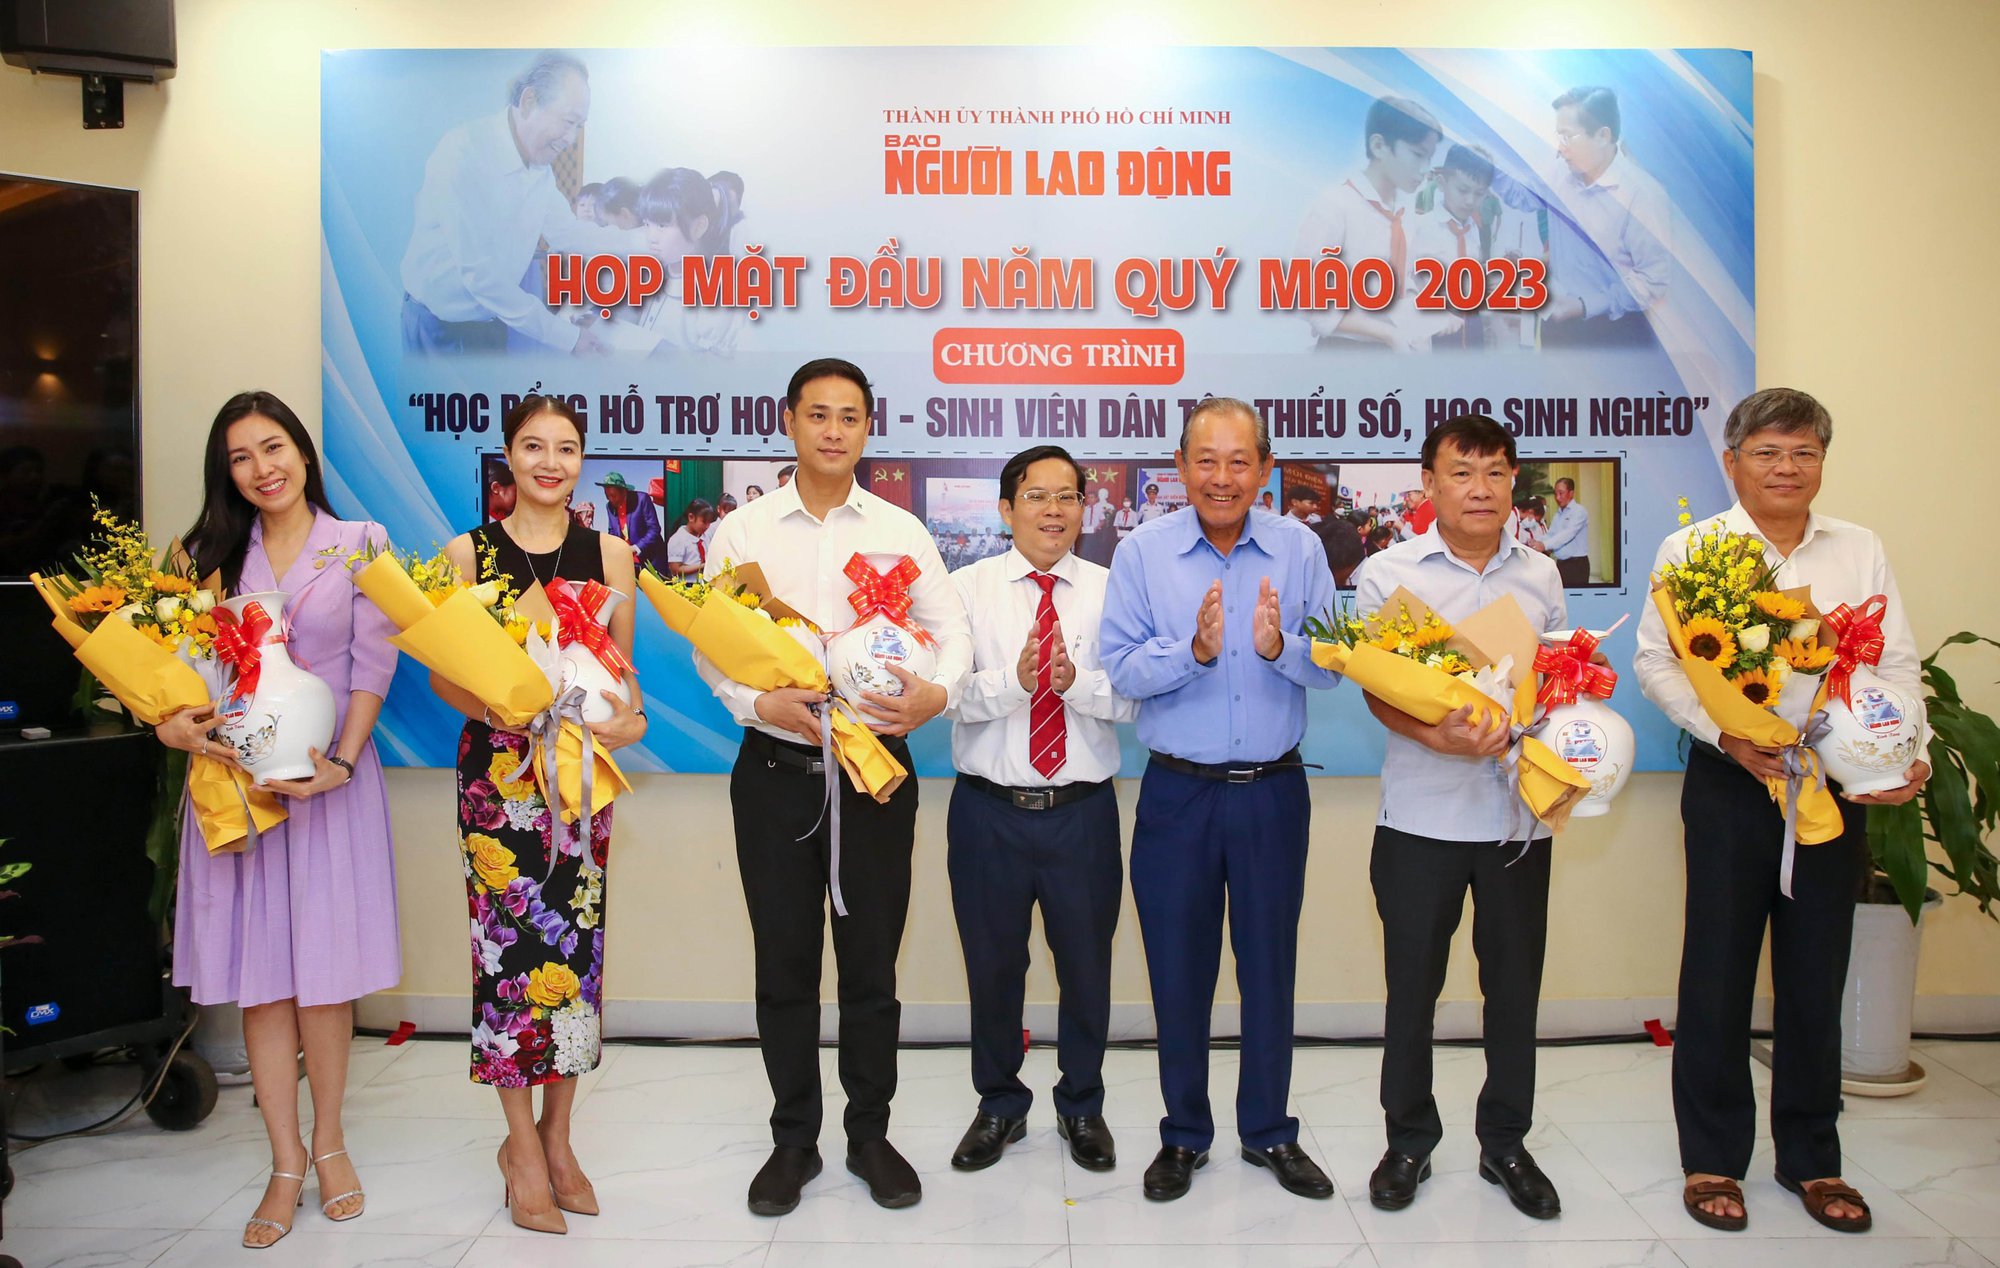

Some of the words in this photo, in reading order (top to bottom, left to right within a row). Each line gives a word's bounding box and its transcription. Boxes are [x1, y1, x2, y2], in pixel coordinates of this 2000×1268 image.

[883, 106, 951, 124] THÀNH
[986, 106, 1055, 125] THÀNH
[1139, 107, 1175, 125] CHÍ
[1179, 110, 1232, 125] MINH
[884, 134, 941, 147] BÁO
[884, 145, 1013, 195] NGƯỜI
[1025, 150, 1105, 196] LAO
[1116, 146, 1231, 199] ĐỘNG
[547, 254, 664, 320] HỌP
[682, 244, 807, 321] MẶT
[824, 237, 942, 309] ĐẦU
[961, 245, 1094, 310] NĂM
[1113, 246, 1240, 317] QUÝ
[1258, 246, 1396, 311] MÃO
[1414, 257, 1548, 311] 2023
[940, 342, 1073, 368] CHƯƠNG
[1081, 338, 1177, 368] TRÌNH
[605, 384, 645, 434] HỖ
[655, 393, 721, 444] TRỢ
[925, 396, 1003, 438] SINH
[1017, 392, 1087, 438] VIÊN
[1100, 392, 1166, 439] DÂN
[1254, 385, 1347, 439] THIỂU
[1358, 389, 1411, 443] SỐ,
[1503, 396, 1580, 438] SINH
